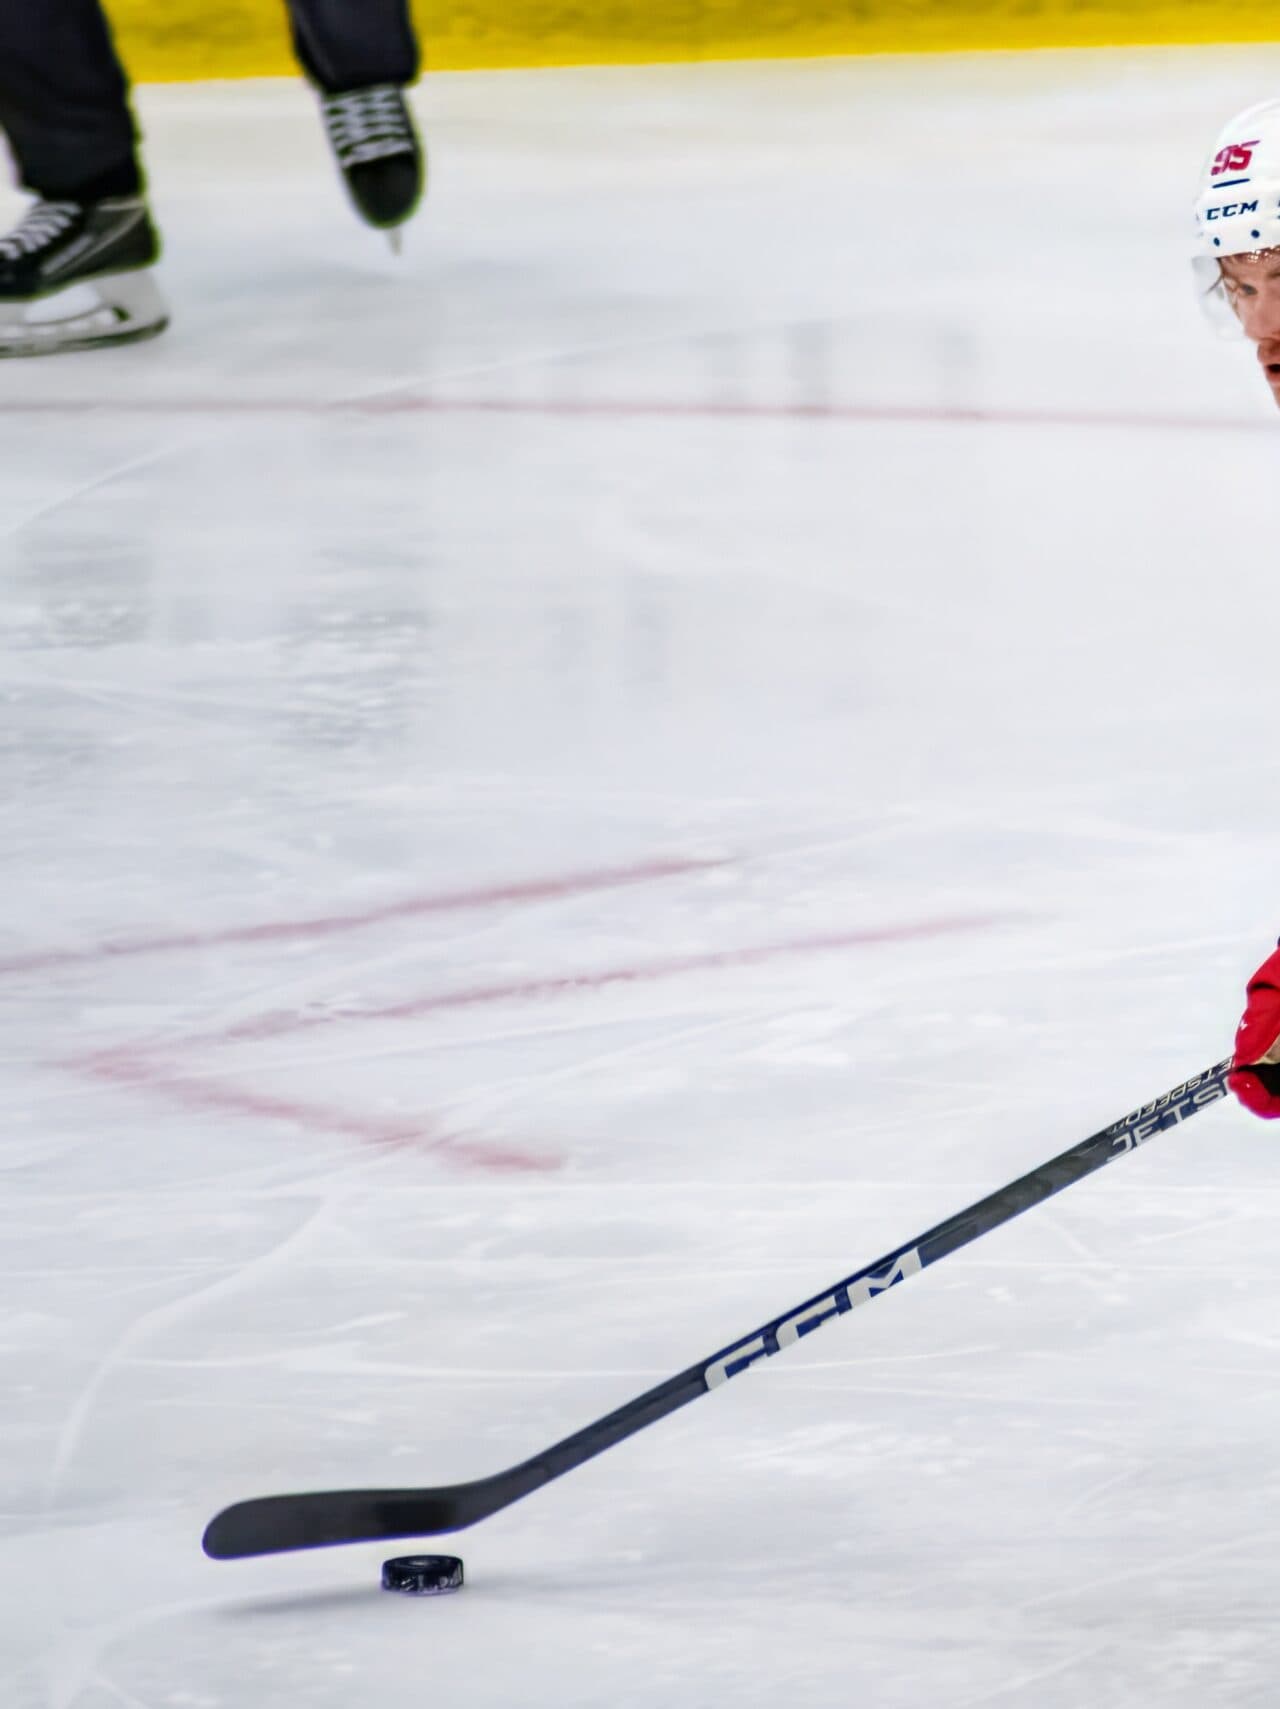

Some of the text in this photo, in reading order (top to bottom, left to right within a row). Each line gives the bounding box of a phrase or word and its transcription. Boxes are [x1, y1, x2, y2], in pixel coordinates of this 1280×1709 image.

[1210, 139, 1260, 176] 95
[1206, 199, 1259, 221] CCM
[1107, 1076, 1232, 1162] JETS
[1125, 1056, 1234, 1127] ETSPEED
[704, 1246, 922, 1391] CCM
